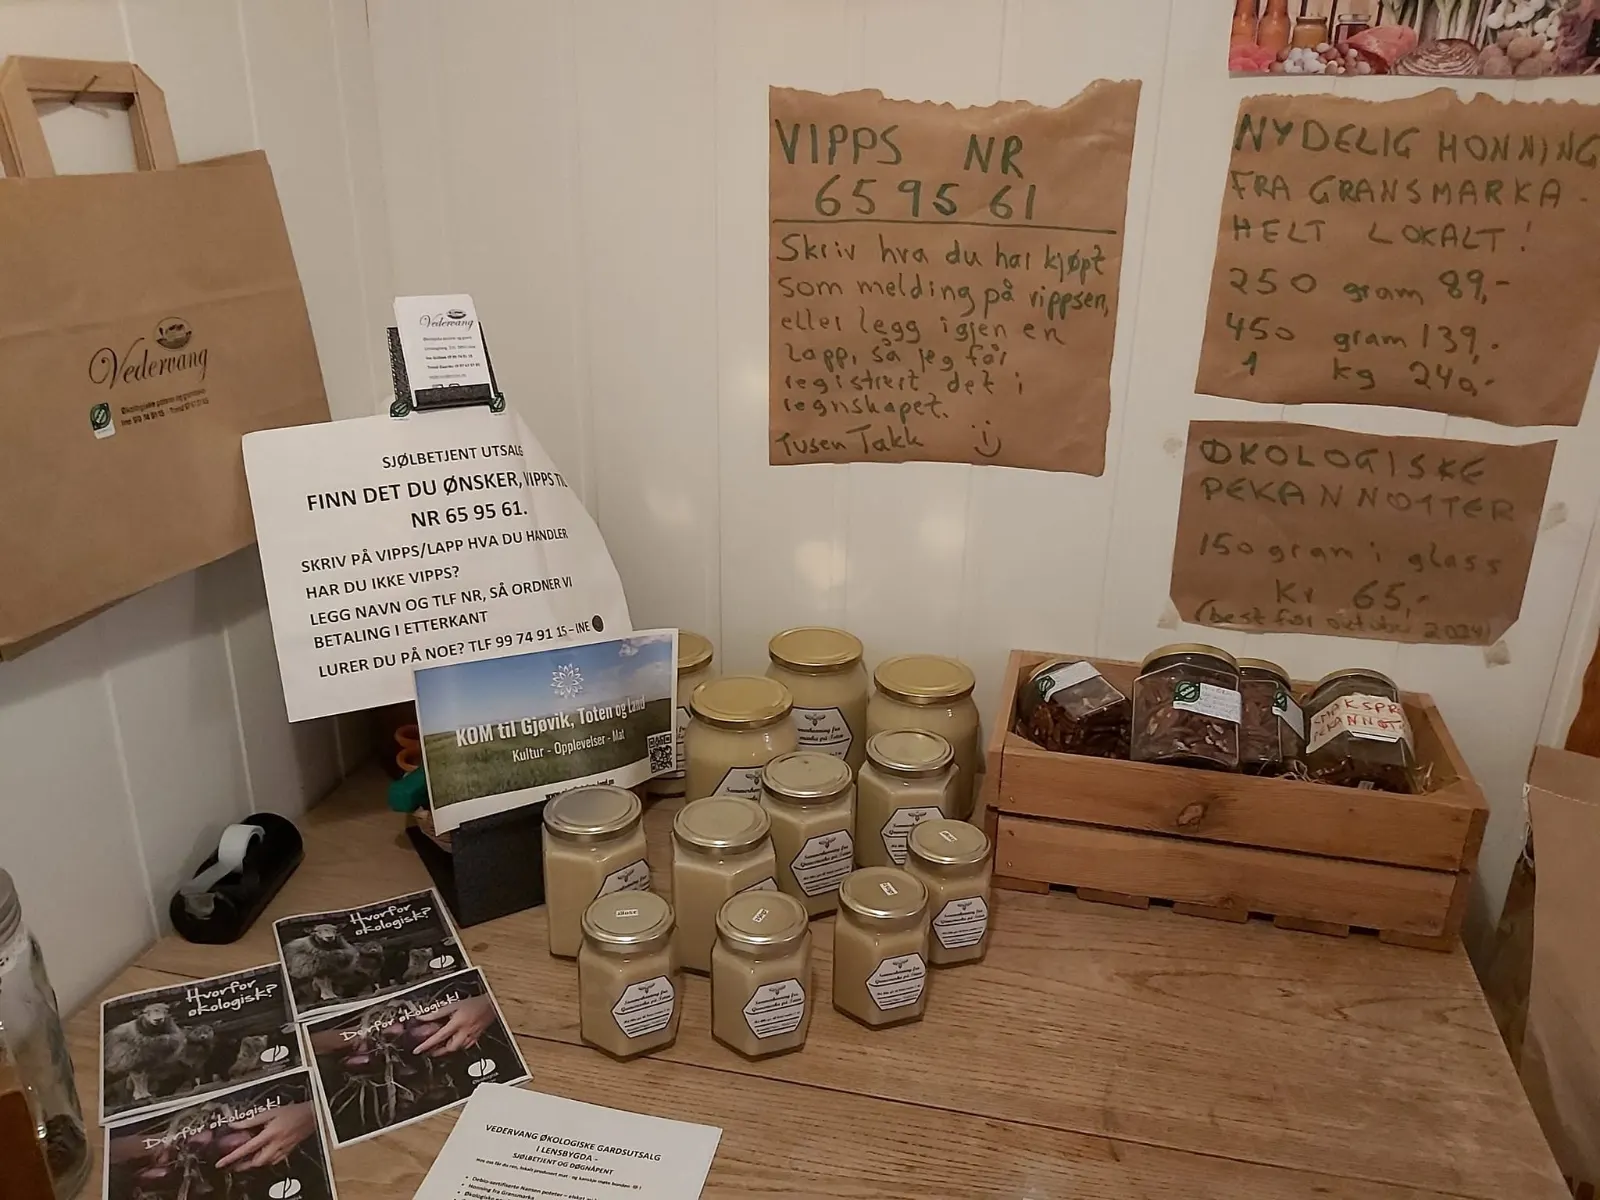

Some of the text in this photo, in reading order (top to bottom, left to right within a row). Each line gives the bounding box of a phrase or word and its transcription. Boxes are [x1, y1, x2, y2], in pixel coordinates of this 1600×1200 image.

[775, 119, 1023, 179] VIPPS NR
[1234, 114, 1600, 169] NYDELIG HONNING
[815, 174, 1036, 220] 65 95 61
[1231, 170, 1561, 208] FRA GRANSMARKA
[1233, 215, 1325, 243] HELT
[776, 234, 856, 263] Skriv
[946, 240, 983, 267] du
[995, 241, 1031, 267] har
[1044, 245, 1105, 283] kjøpt
[860, 273, 975, 317] melding
[985, 279, 1014, 319] på
[1229, 268, 1316, 295] 250
[1343, 282, 1423, 306] gram
[419, 313, 474, 331] Vedervang
[781, 307, 1066, 346] eller legg igjen en
[1226, 312, 1295, 341] 450
[1334, 331, 1406, 352] gram
[89, 338, 208, 389] Vedervang
[872, 339, 902, 362] så
[921, 344, 953, 372] jeg
[1242, 351, 1257, 375] 1
[1334, 358, 1375, 390] kg
[947, 371, 994, 394] det
[1015, 372, 1023, 394] i
[382, 444, 524, 469] SJØLBETJENT UTSALG
[776, 424, 923, 456] Tusen Takk
[307, 491, 357, 511] FINN
[363, 484, 401, 505] DET
[407, 481, 437, 498] DU
[443, 472, 523, 496] ØNSKER,
[523, 471, 554, 488] VIPPS
[411, 500, 528, 528] NR 65 95 61.
[301, 528, 568, 574] SKRIV PÅ VIPPS/LAPP HVA DU HANDLER
[1200, 533, 1253, 556] 150
[1270, 543, 1353, 563] gram
[1409, 543, 1500, 575] glass
[306, 566, 460, 600] HAR DU IKKE VIPPS?
[310, 576, 573, 627] LEGG NAVN OG TLF NR, SÅ ORDNER VI
[1276, 579, 1315, 604] Kr
[314, 611, 488, 650] BETALING I ETTERKANT
[318, 659, 369, 678] LURER
[373, 654, 397, 669] DU
[401, 647, 422, 665] PÅ
[426, 642, 464, 661] NOE?
[468, 638, 492, 654] TLF
[495, 633, 513, 649] 99
[516, 630, 533, 645] 74
[537, 627, 553, 642] 91
[576, 622, 590, 633] INE
[456, 695, 646, 747] KOM til Gjøvik, Toten og Land
[512, 747, 544, 762] Kultur
[554, 736, 605, 756] Opplevelser
[612, 729, 625, 743] Mat
[349, 903, 412, 925] Hvorfor
[186, 978, 257, 1002] Hvorfor
[485, 1124, 662, 1162] VEDERVANG ØKOLOGISKE GARDSUTSALG
[541, 1146, 592, 1162] LENSBYGDA
[512, 1152, 614, 1176] SJØLBETJENT OG DØGNÅPENT
[468, 1183, 491, 1193] Honning
